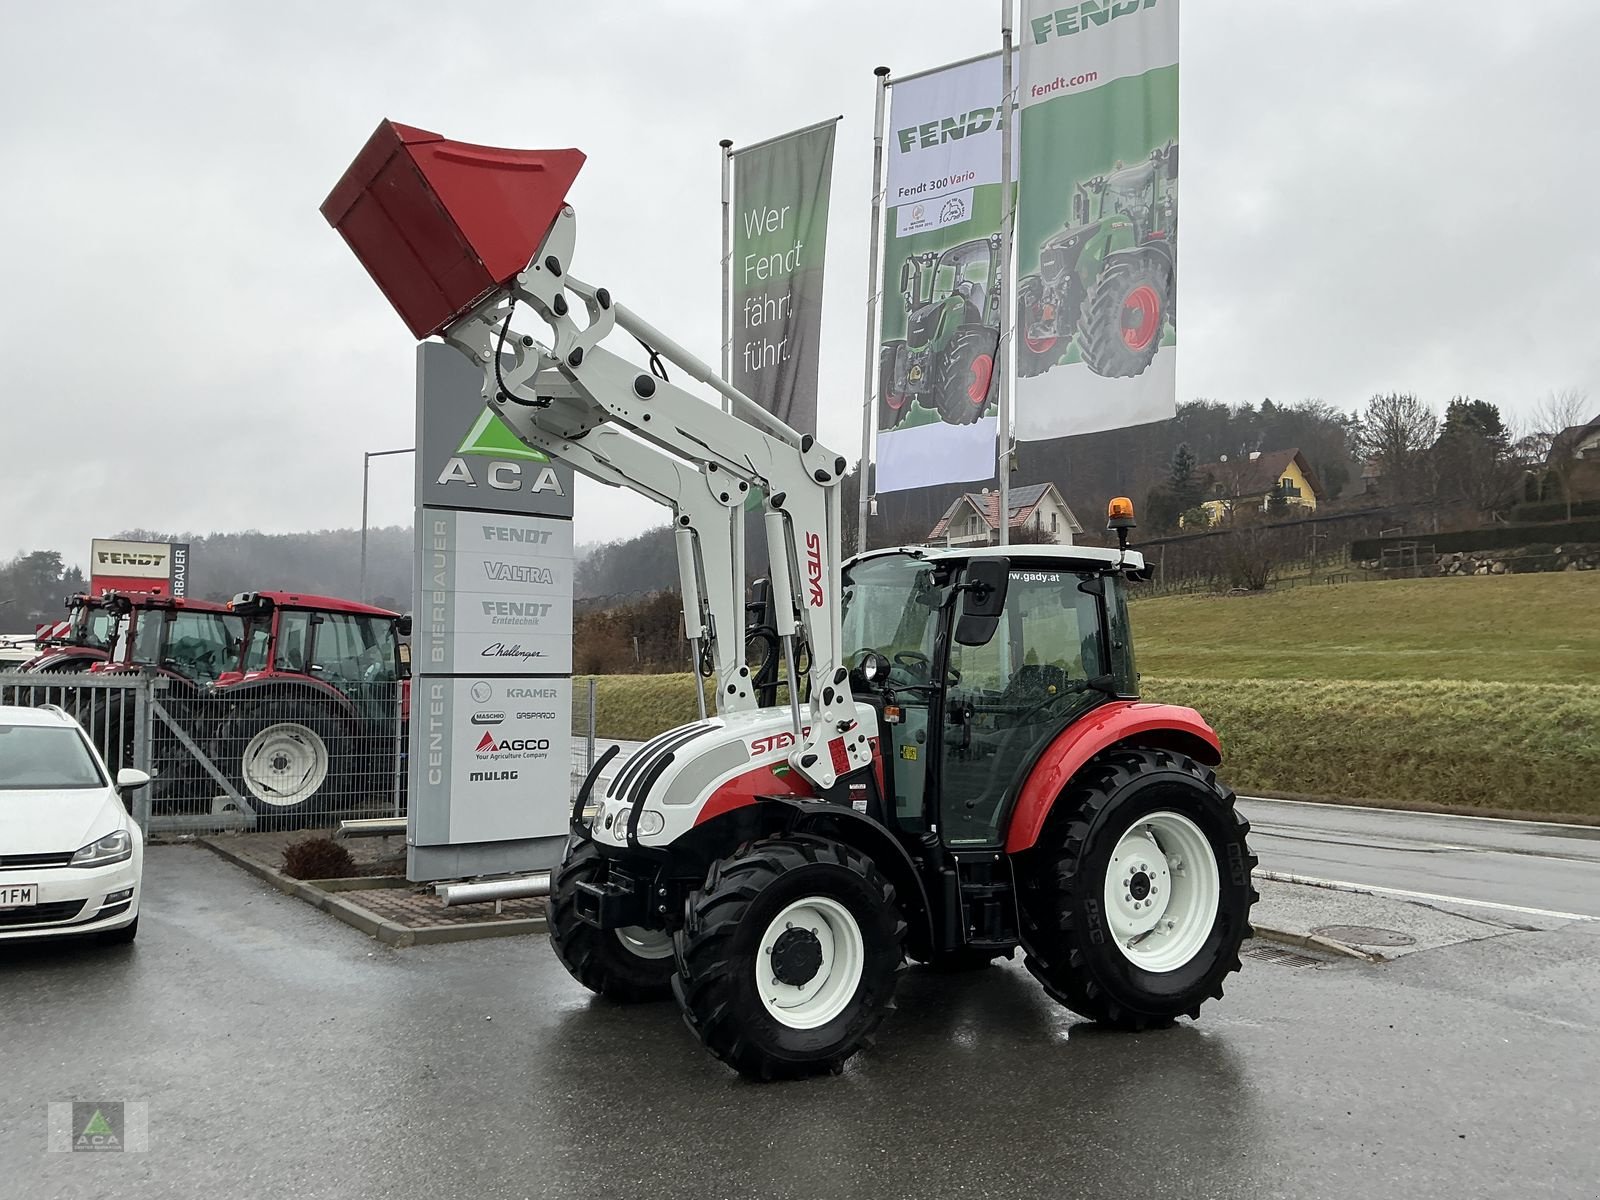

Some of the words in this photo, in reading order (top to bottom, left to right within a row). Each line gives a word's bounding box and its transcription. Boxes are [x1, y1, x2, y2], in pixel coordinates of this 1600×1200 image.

[1031, 71, 1098, 97] fendt.com
[898, 183, 927, 198] Fendt
[929, 177, 948, 191] 300
[949, 171, 975, 185] Vario
[744, 205, 790, 240] Wer
[744, 240, 803, 285] Fendt
[743, 290, 793, 329] fährt,
[743, 334, 791, 373] führt.
[436, 457, 566, 496] ACA
[482, 525, 552, 545] FENDT
[97, 551, 166, 566] FENDT
[805, 531, 823, 608] STEYR
[174, 549, 186, 600] RBAUER
[483, 561, 553, 584] VALTRA
[431, 520, 447, 662] BIERBAUER
[482, 601, 552, 617] FENDT
[492, 616, 539, 626] Erntetechnik
[481, 642, 549, 662] Challenger
[506, 688, 557, 699] KRAMER
[516, 712, 556, 720] GASPARDO
[428, 684, 444, 785] CENTER
[499, 739, 550, 751] AGCO
[490, 753, 522, 761] Agriculture
[523, 752, 548, 760] Company
[469, 771, 518, 782] MULAG
